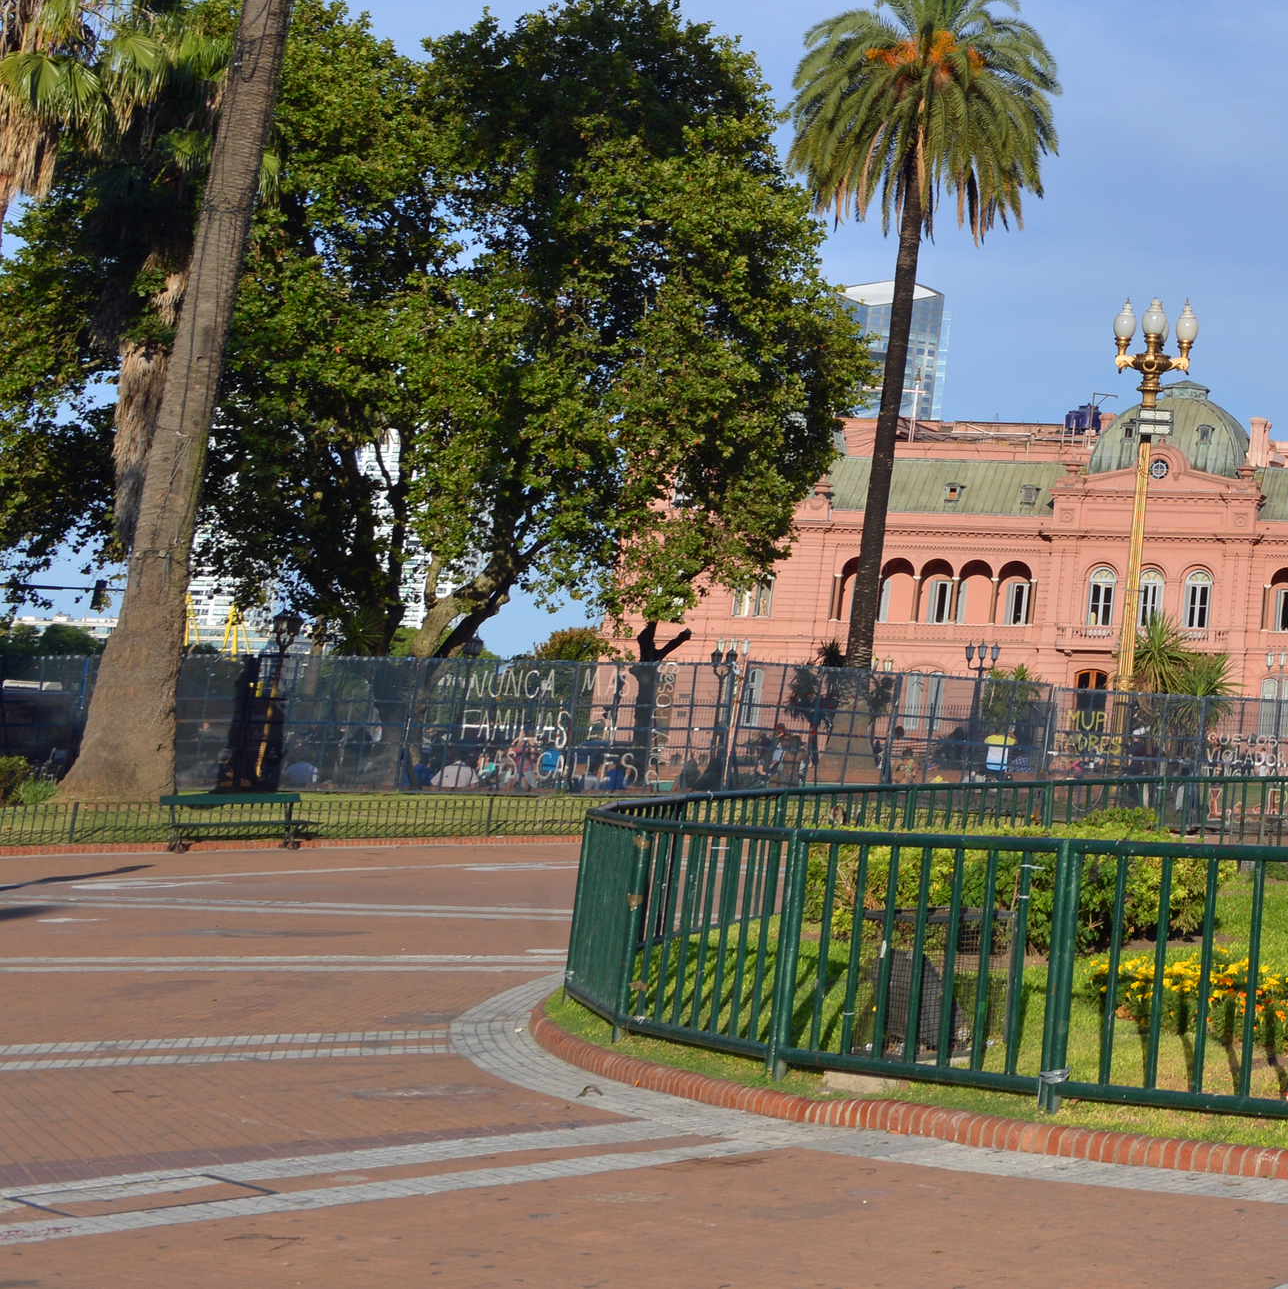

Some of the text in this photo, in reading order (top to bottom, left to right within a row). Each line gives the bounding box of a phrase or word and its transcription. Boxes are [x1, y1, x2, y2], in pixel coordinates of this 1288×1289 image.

[466, 667, 631, 701] NUNCA MAS
[1066, 710, 1107, 732] MUP
[1206, 732, 1278, 748] QUE LOS
[536, 751, 639, 787] CALLES
